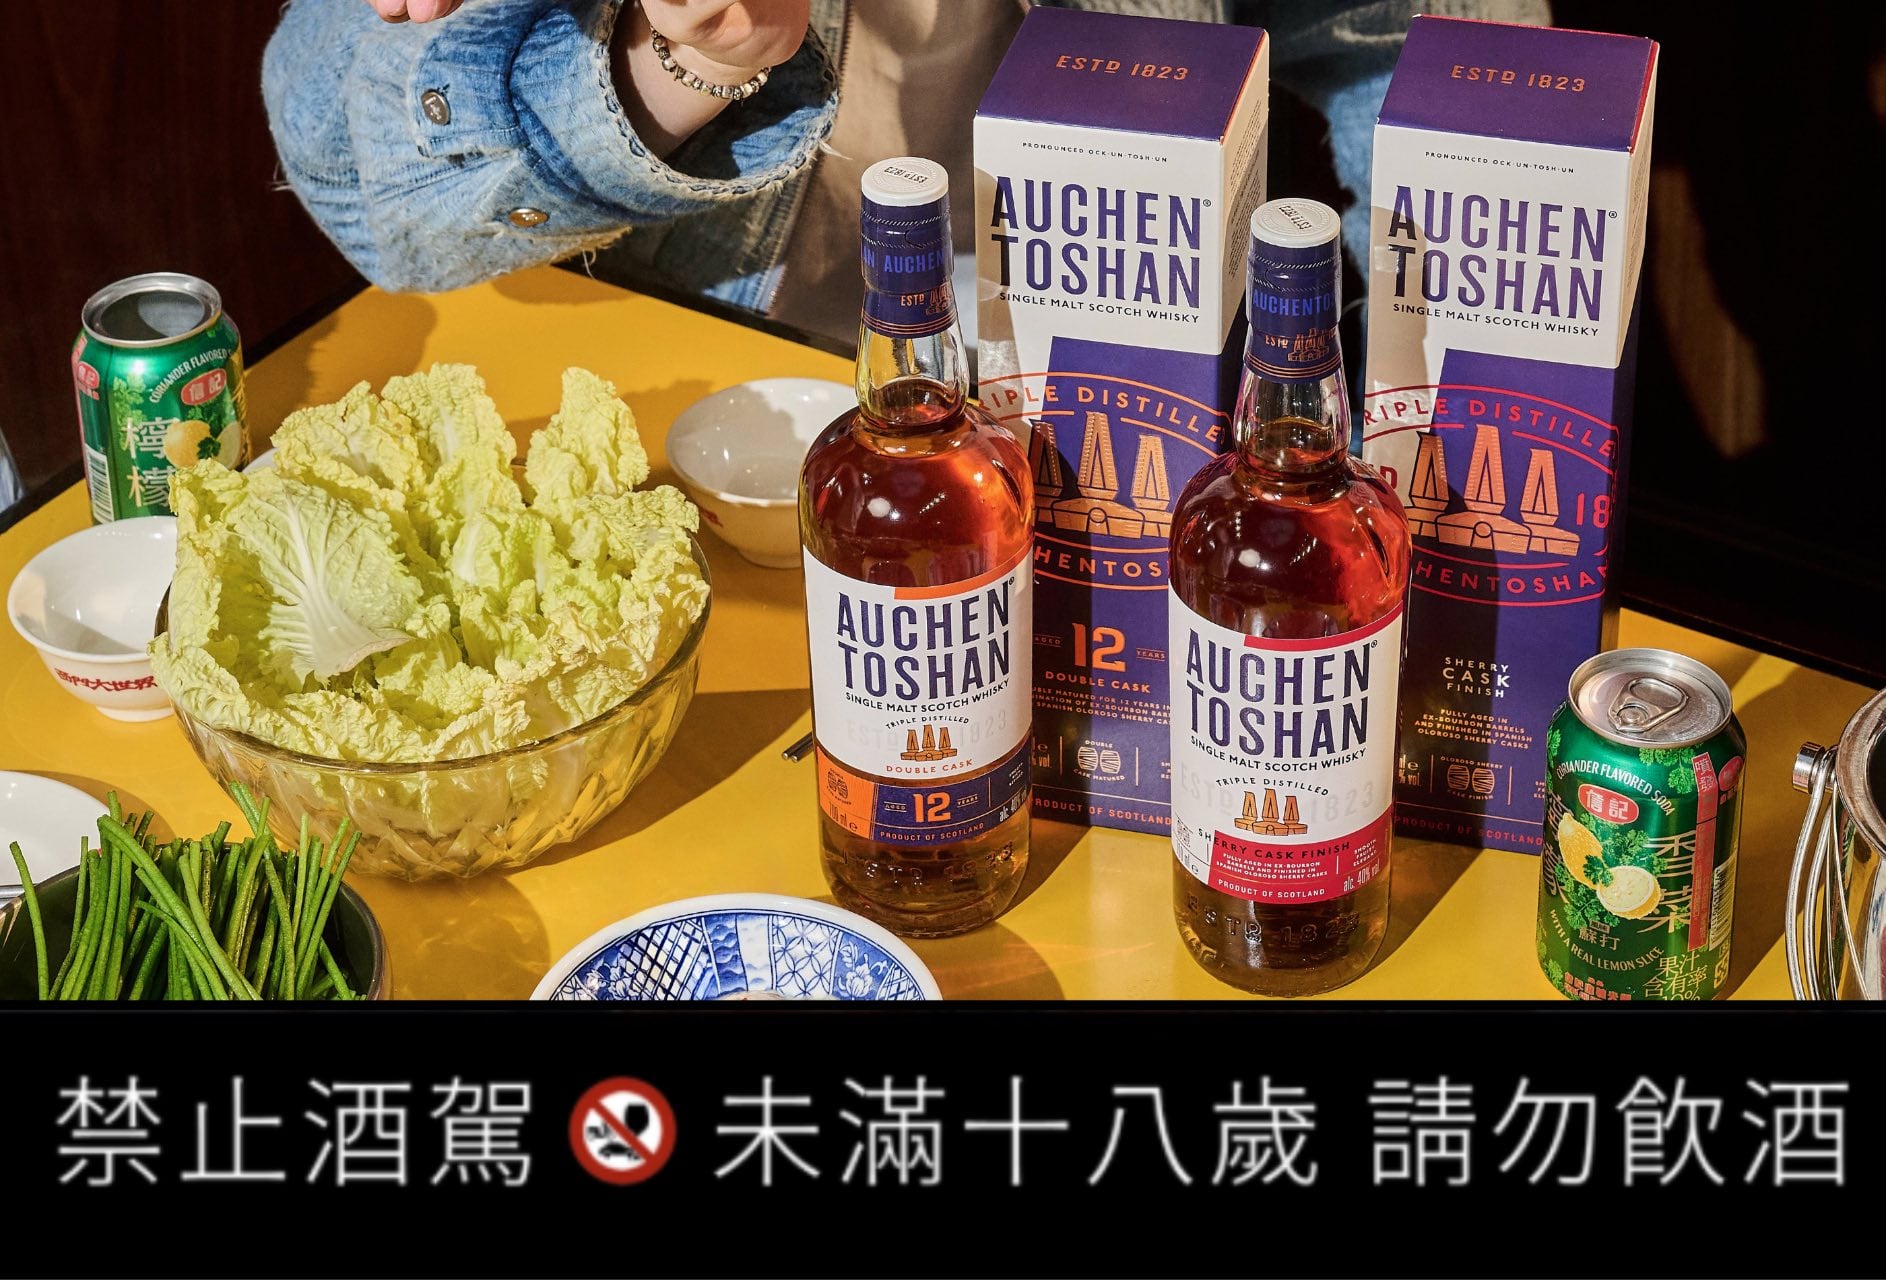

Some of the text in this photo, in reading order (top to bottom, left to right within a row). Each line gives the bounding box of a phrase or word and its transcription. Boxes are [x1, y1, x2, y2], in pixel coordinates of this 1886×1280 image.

[1130, 60, 1189, 80] 1823
[1527, 73, 1586, 92] 1823
[1022, 142, 1084, 154] PRONOUNCED
[1425, 151, 1488, 164] PRONOUNCED
[991, 233, 1200, 309] TOSHAN
[1388, 243, 1603, 322] TOSHAN
[1000, 292, 1199, 324] SINGLE MALT SCOTCH WHISKY
[1252, 289, 1335, 317] AUCHENTO
[1393, 303, 1599, 337] SINGLE MALT SCOTCH WHISKY
[149, 348, 228, 404] CORIANDER FLAVORED
[978, 385, 1226, 445] RIPLE DISTILLE
[1363, 398, 1617, 458] RIPLE DISTILLE
[1575, 492, 1613, 529] 18
[1416, 560, 1608, 594] HENTOSHA
[1071, 622, 1126, 673] 12
[1136, 650, 1165, 659] YEARS
[838, 631, 1009, 700] TOSHAN
[1444, 656, 1509, 673] SHERRY
[1045, 671, 1151, 694] DOUBLE CASK
[1442, 667, 1510, 688] CASK
[846, 678, 1009, 713] SINGLE MALT SCOTCH WHISKY
[1055, 689, 1096, 700] MATURED
[1099, 696, 1116, 704] FOR
[1133, 700, 1160, 709] YEARS
[1446, 682, 1504, 698] FINISH
[1036, 701, 1153, 723] SPANISH OLOROSO SHERRY
[1090, 702, 1148, 715] EX-BOURBON
[1186, 679, 1369, 758] TOSHAN
[1440, 709, 1466, 719] FULLY
[1470, 713, 1495, 722] AGED
[885, 715, 970, 729] TRIPLE DISTILLED
[1414, 720, 1434, 728] AND
[1436, 723, 1478, 735] FINISHED
[1494, 732, 1533, 743] SPANISH
[1423, 713, 1525, 734] EX-BOURBON BARRELS
[1085, 740, 1113, 748] DOUBLE
[1418, 728, 1529, 750] OLOROSO SHERRY CASKS
[1191, 735, 1366, 772] SINGLE MALT SCOTCH WHISKY
[886, 758, 973, 774] DOUBLE CASK
[1216, 777, 1329, 797] TRIPLE DISTILLED
[1557, 759, 1677, 817] CORIANDER FLAVORED SODA
[913, 791, 951, 823] 12
[957, 795, 979, 806] YEARS
[1035, 798, 1083, 813] RODUCT
[1089, 806, 1104, 815] OF
[1109, 809, 1172, 826] SCOTLAND
[880, 831, 921, 841] PRODUCT
[940, 822, 985, 839] SCOTLAND
[1478, 827, 1544, 846] SCOTLAND
[1198, 828, 1350, 860] SHERRY CASK FINISH
[1223, 853, 1242, 863] FULLY
[1216, 861, 1242, 874] SPANISH
[1244, 870, 1276, 879] OLOROSO
[1218, 878, 1325, 898] PRODUCT OF SCOTLAND
[1570, 943, 1595, 966] REAL
[1598, 957, 1636, 971] LEMON
[1635, 946, 1665, 968] SLICE
[1655, 950, 1700, 977] 果汁
[1643, 964, 1708, 998] 含有率
